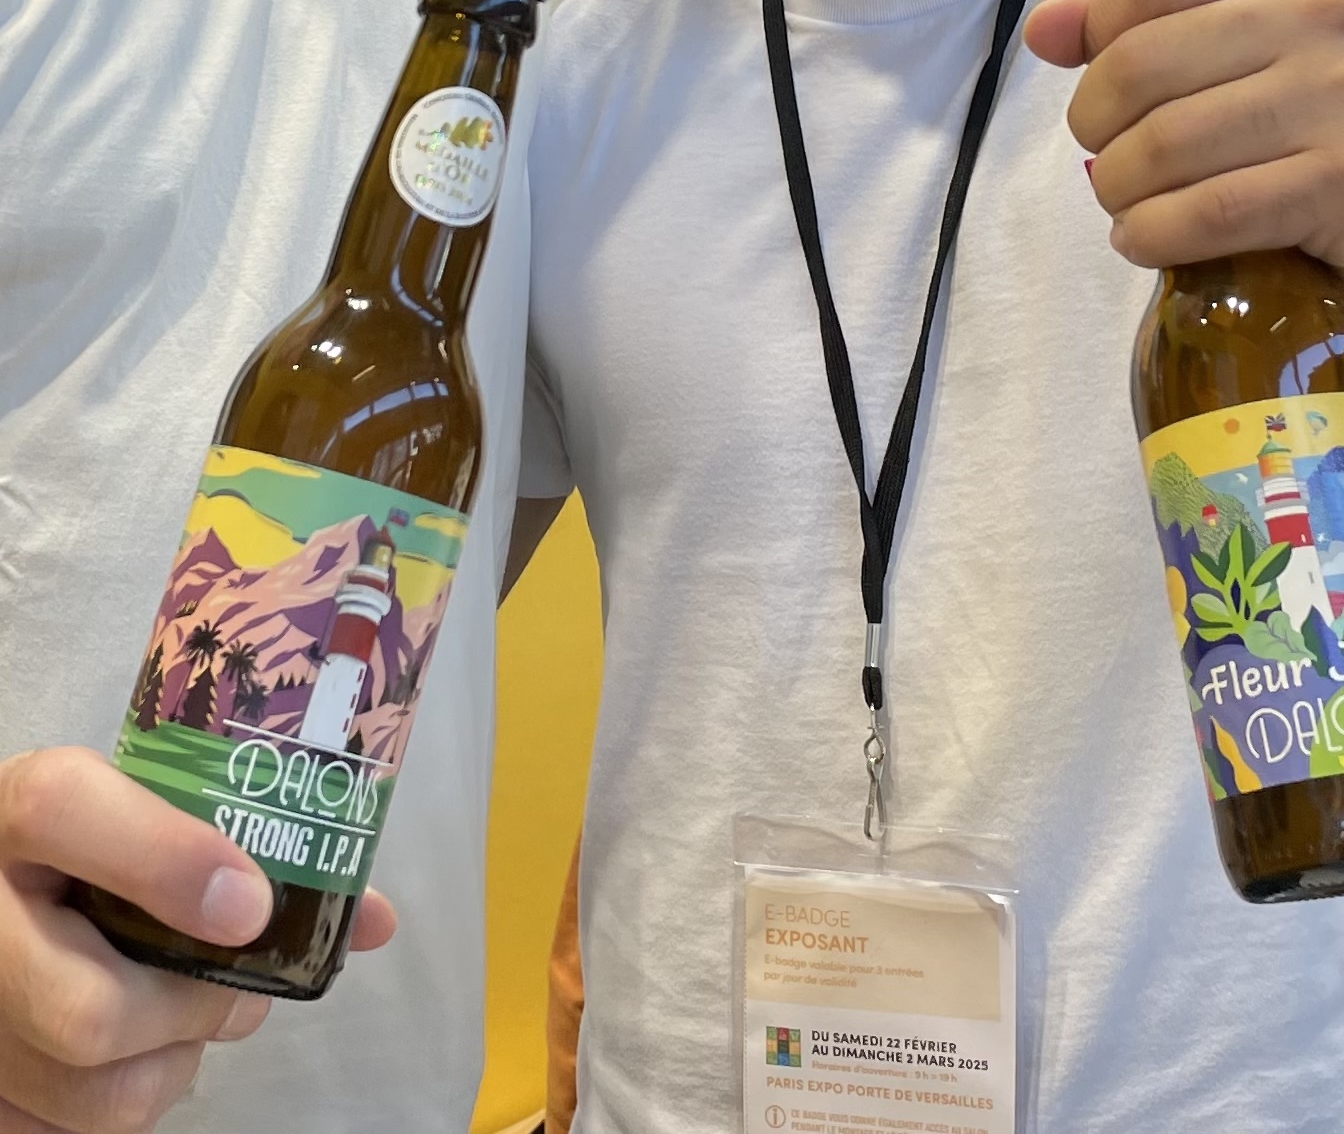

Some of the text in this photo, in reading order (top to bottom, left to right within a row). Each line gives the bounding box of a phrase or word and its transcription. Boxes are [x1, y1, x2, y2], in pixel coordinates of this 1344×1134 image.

[1201, 659, 1312, 705] Fleur
[228, 738, 381, 825] DALONS
[214, 804, 315, 867] STRONG
[764, 903, 851, 928] E-BADGE
[765, 928, 869, 954] EXPOSANT
[811, 1030, 957, 1054] DU SAMEDI 22 FÉVRIER
[811, 1044, 989, 1071] AU DIMANCHE 2 MARS 2025
[766, 1076, 994, 1110] PARIS EXPO PORTE DE VERSAILLES
